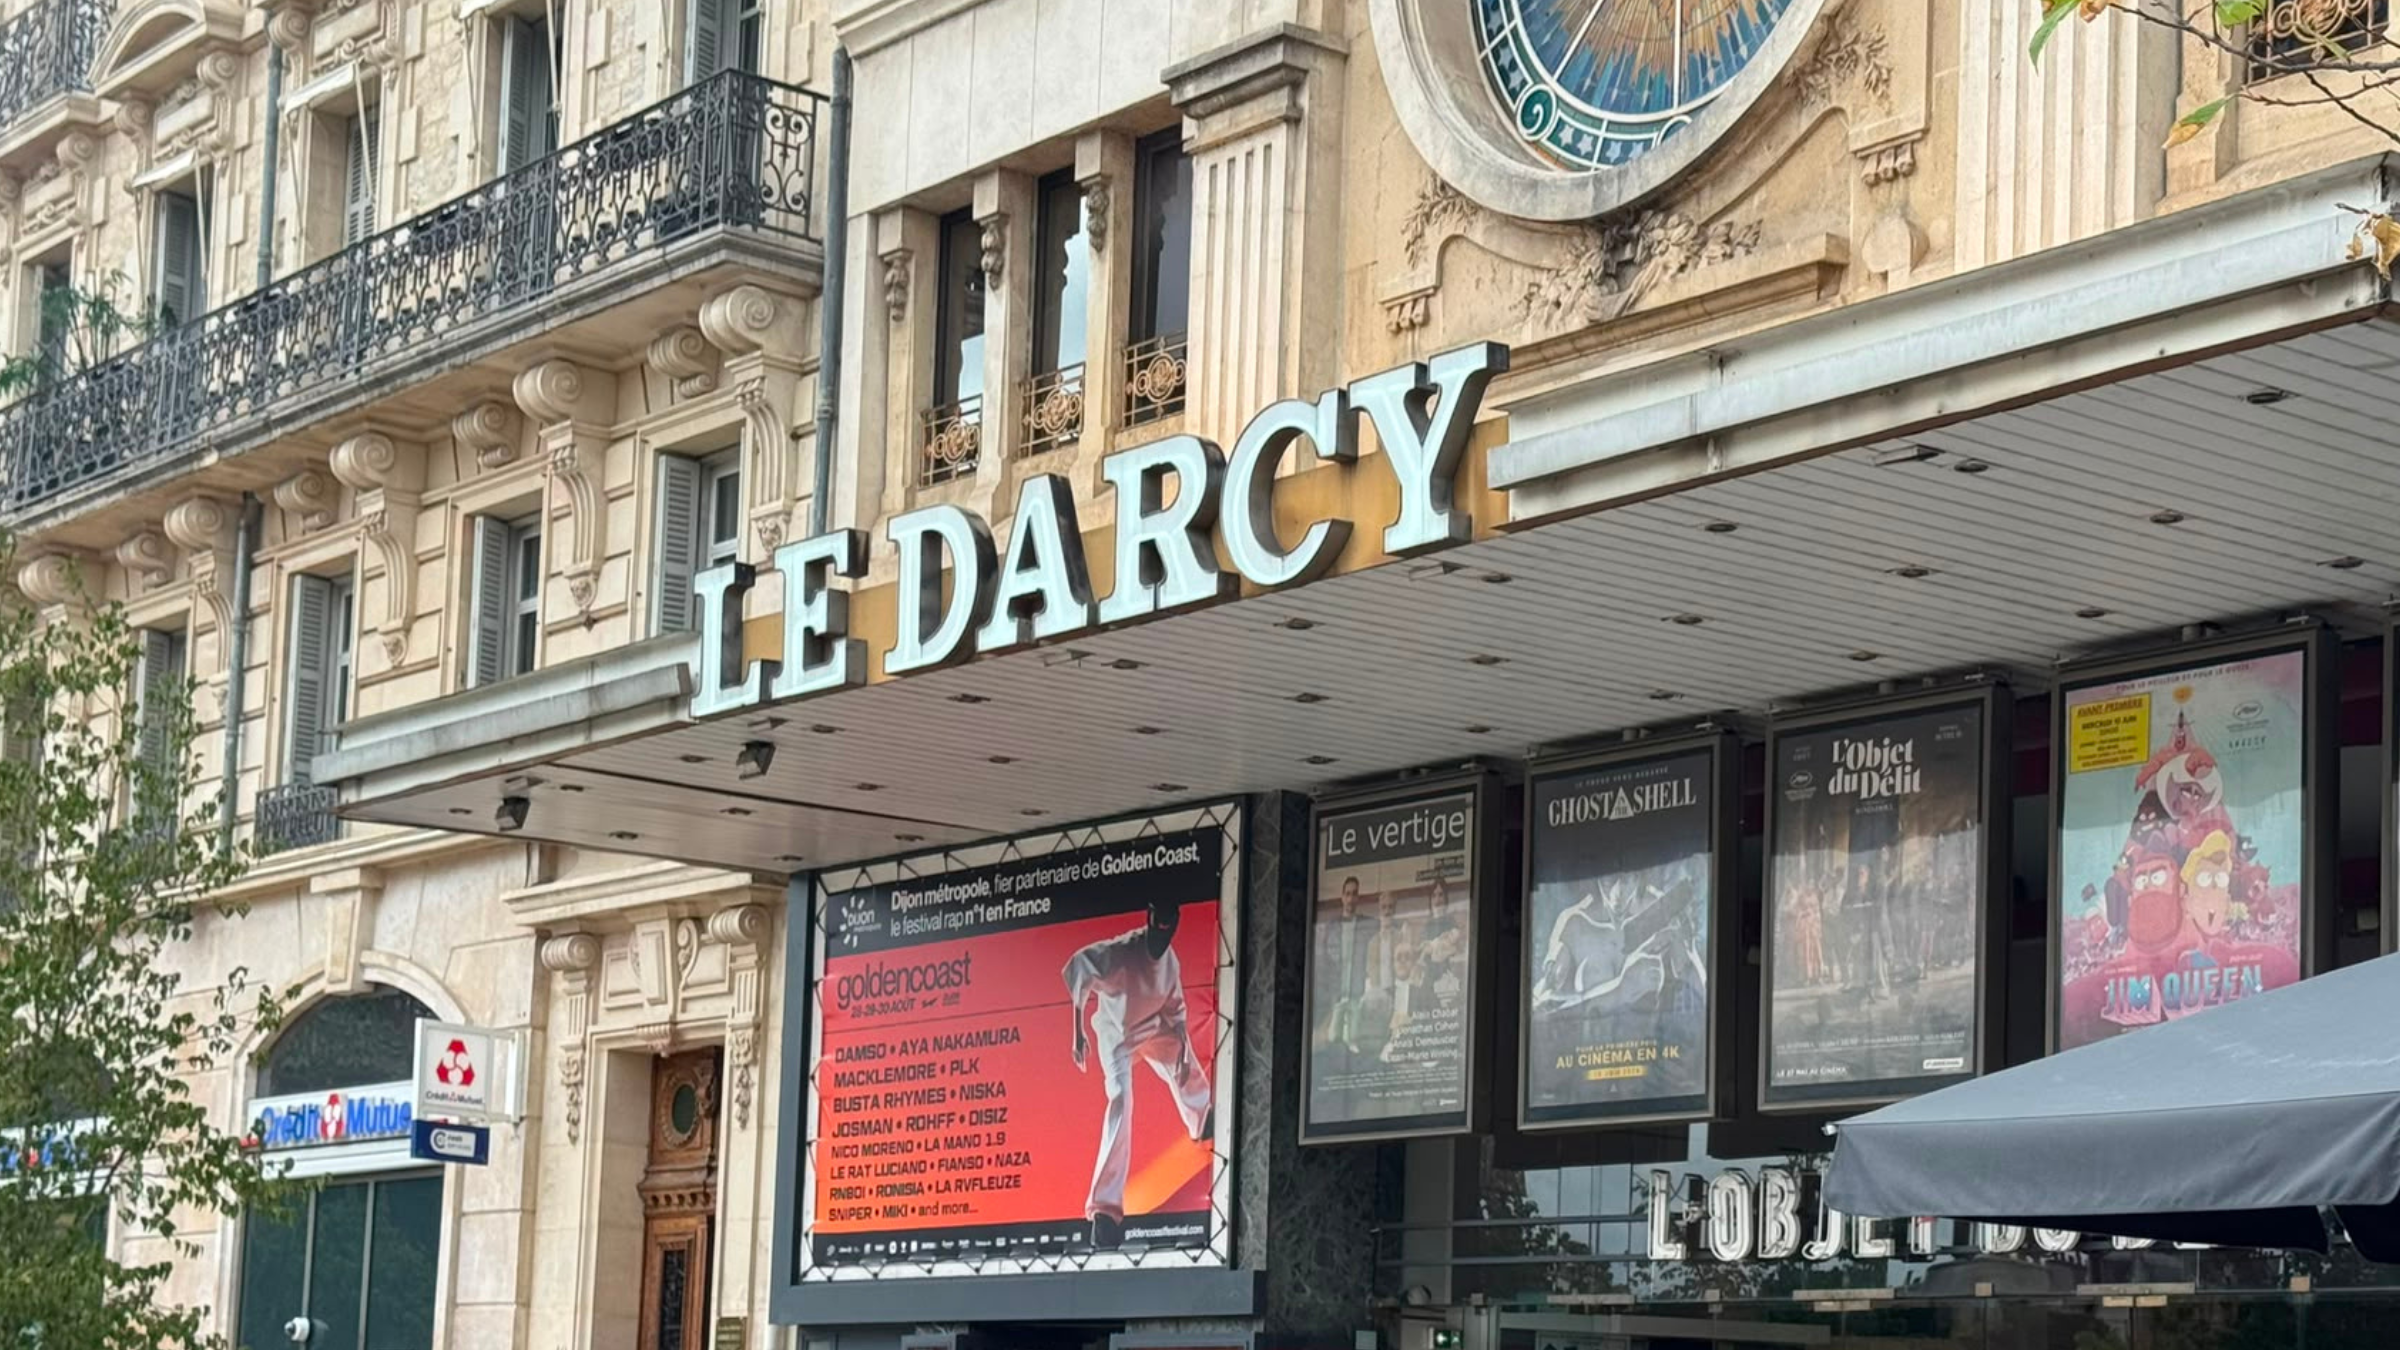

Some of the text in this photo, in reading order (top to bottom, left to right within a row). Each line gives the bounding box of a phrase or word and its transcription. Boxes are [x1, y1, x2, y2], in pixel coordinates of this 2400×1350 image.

[689, 339, 1510, 718] LE DARCY
[1832, 737, 1913, 774] L'Objet
[1828, 767, 1859, 795] du
[1860, 764, 1921, 800] Délit
[1548, 791, 1613, 827] GHOST
[1633, 778, 1697, 814] SHELL
[1328, 809, 1465, 856] Le vertige
[891, 842, 1200, 912] Dijon métropole, fier partenaire de Golden Coast,
[890, 918, 901, 937] le
[902, 911, 943, 935] festival
[944, 911, 964, 932] rap
[986, 905, 1003, 922] en
[1004, 896, 1050, 919] France
[838, 951, 971, 1010] goldencoast
[2102, 964, 2262, 1016] JIM QUEEN
[835, 1026, 1021, 1063] DAMSO AYA NAKAMURA
[1556, 1054, 1574, 1069] AU
[1637, 1047, 1657, 1061] EN
[1661, 1045, 1681, 1058] 4K
[834, 1057, 979, 1088] MACKLEMORE PLK
[834, 1081, 1006, 1113] BUSTA RHYMES NISKA
[832, 1107, 1007, 1138] JOSMAN ROHFF DISIZ
[831, 1131, 1006, 1159] NICO MORENO LA MANO 1.9
[830, 1151, 1031, 1180] LE RAT LUCIANO FIANSO NAZA
[876, 1182, 925, 1198] RONISIA
[935, 1179, 952, 1194] LA
[954, 1174, 1022, 1192] RVFLEUZE
[829, 1206, 872, 1221] SNIPER
[882, 1204, 907, 1219] MIKI
[919, 1202, 940, 1217] and
